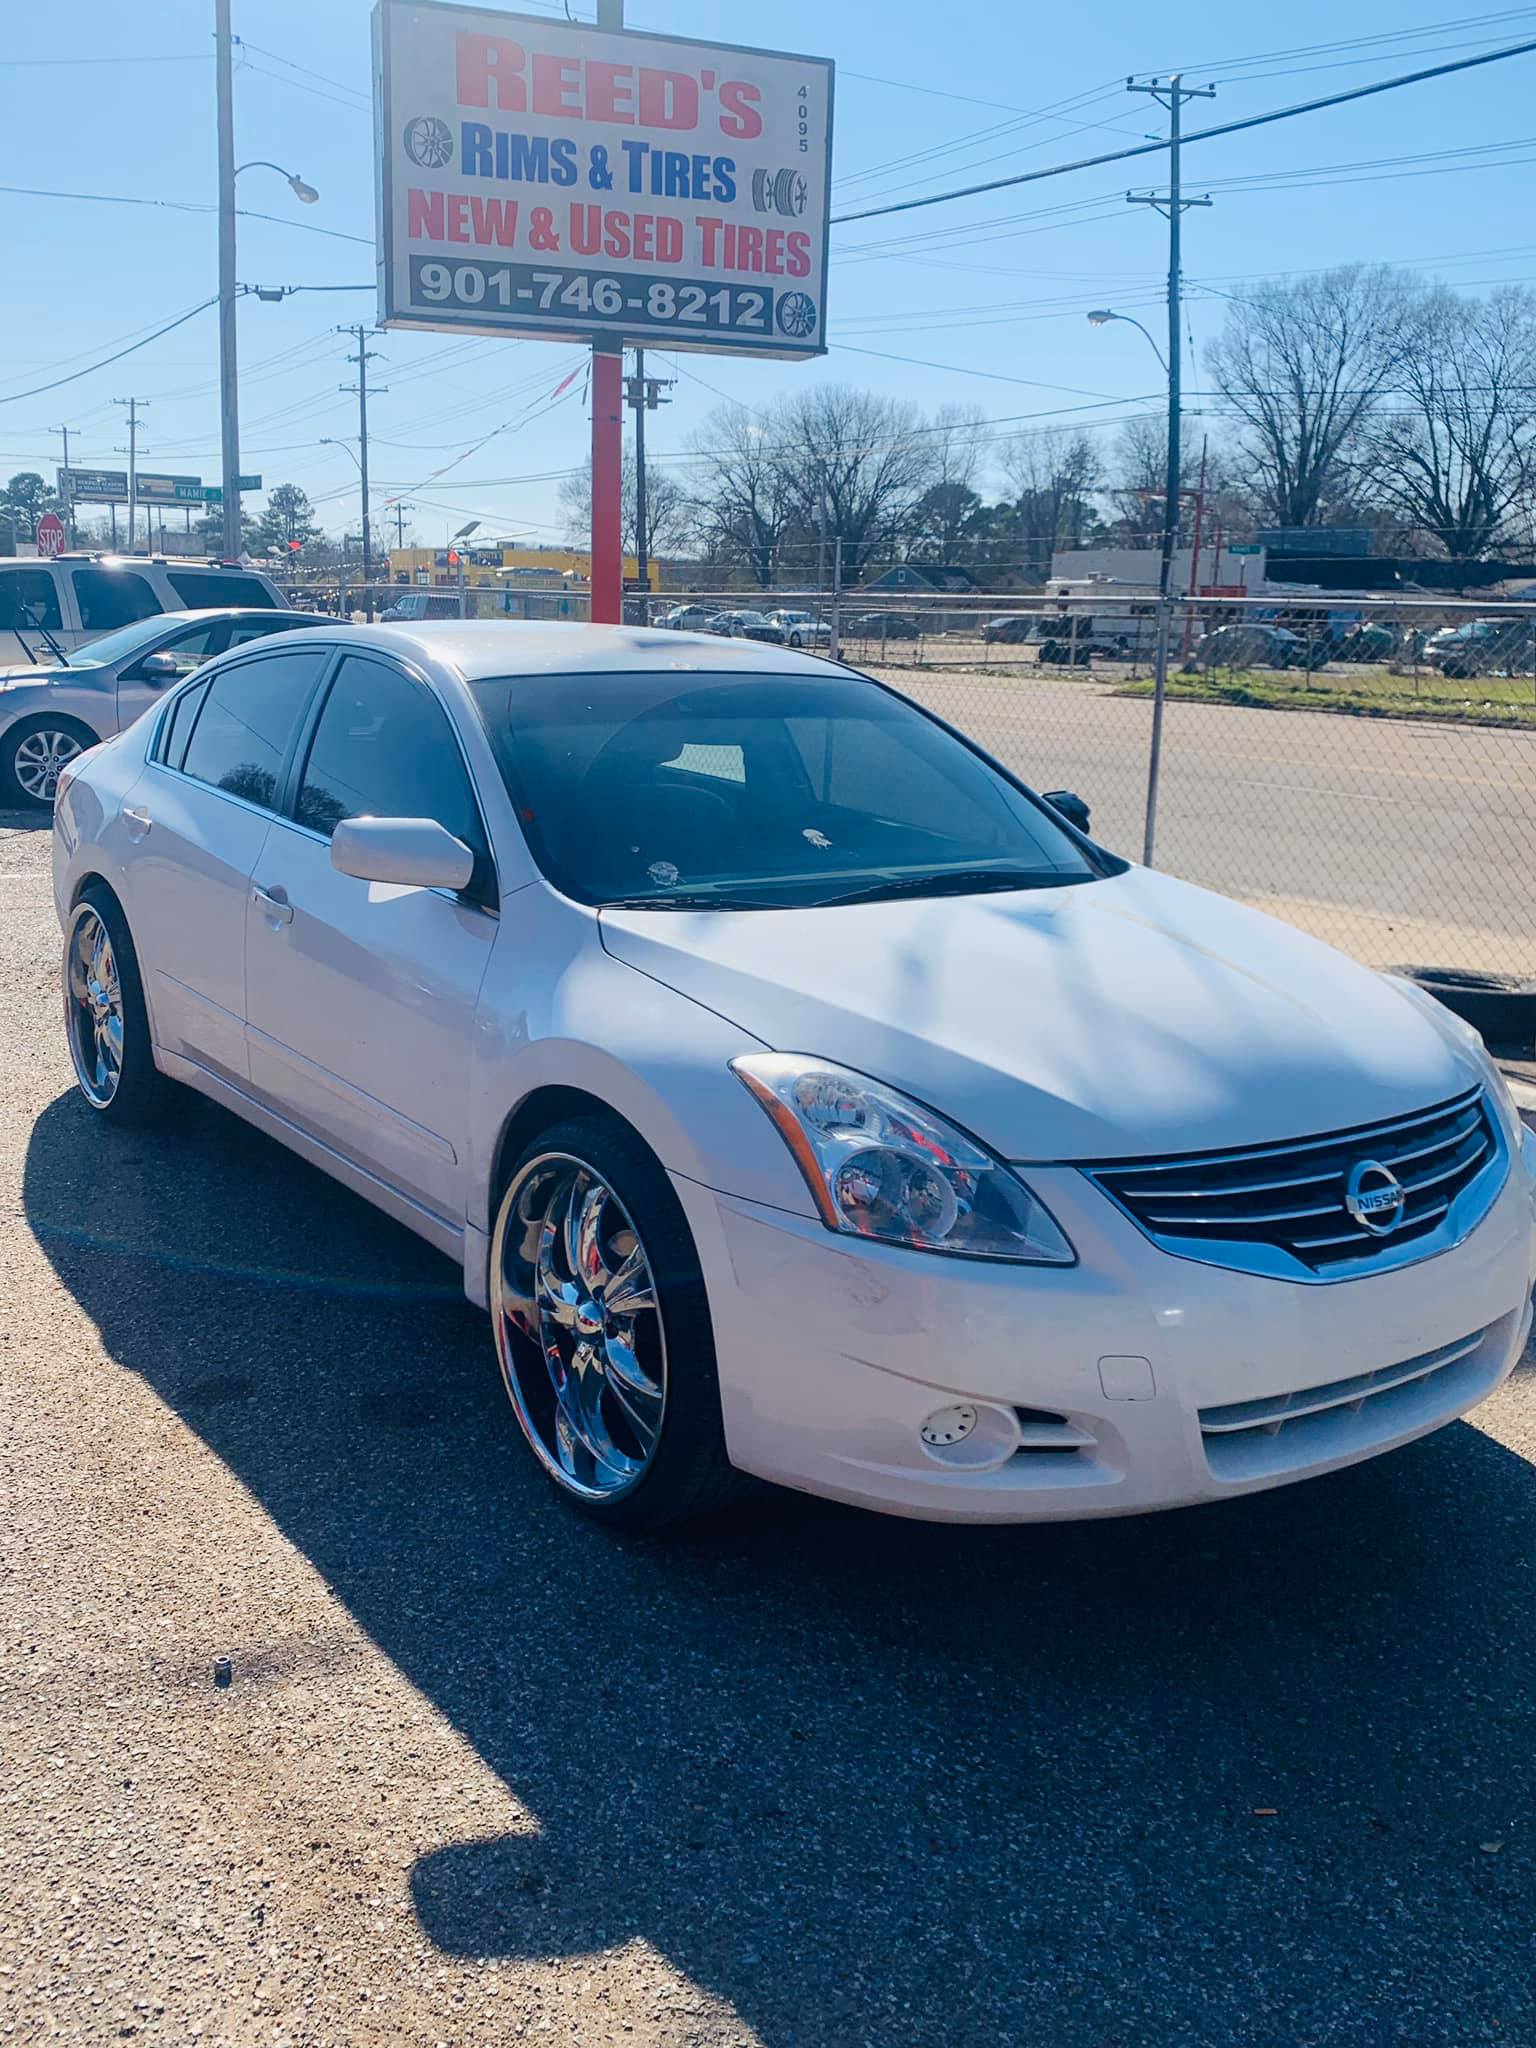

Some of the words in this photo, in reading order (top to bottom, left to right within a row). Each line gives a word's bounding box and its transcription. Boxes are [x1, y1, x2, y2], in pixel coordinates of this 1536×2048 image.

[456, 31, 763, 140] REED'S
[797, 85, 809, 153] 4095
[461, 120, 578, 187] RIMS
[588, 144, 614, 191] &
[622, 139, 737, 203] TIRES
[407, 188, 519, 248] NEW
[528, 206, 560, 252] &
[569, 202, 684, 263] USED
[696, 216, 812, 278] TIRES
[419, 263, 766, 329] 901-746-8212
[40, 529, 63, 548] STOP
